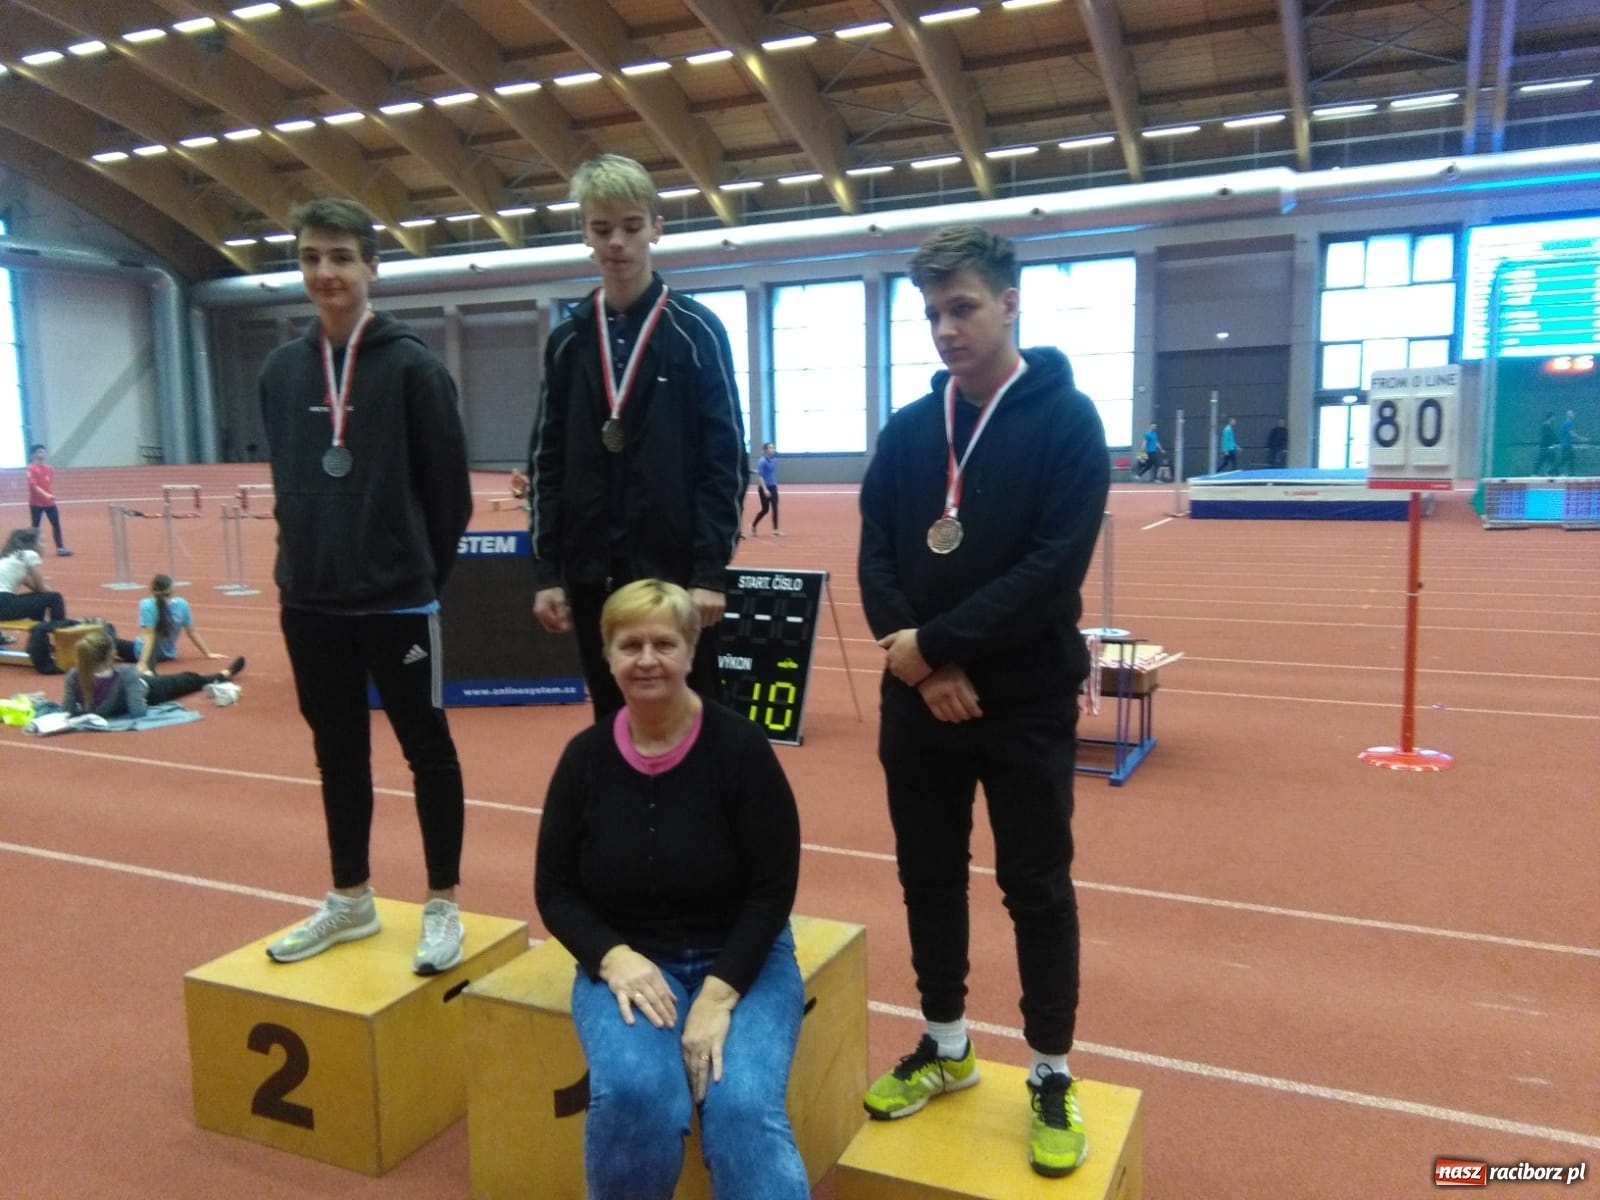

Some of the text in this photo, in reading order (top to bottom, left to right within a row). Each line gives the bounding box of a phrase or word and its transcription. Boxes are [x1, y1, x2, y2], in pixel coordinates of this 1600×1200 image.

[1371, 376, 1408, 389] FROM
[1425, 372, 1457, 387] LINE
[1373, 398, 1443, 448] 80
[246, 1021, 315, 1131] 2
